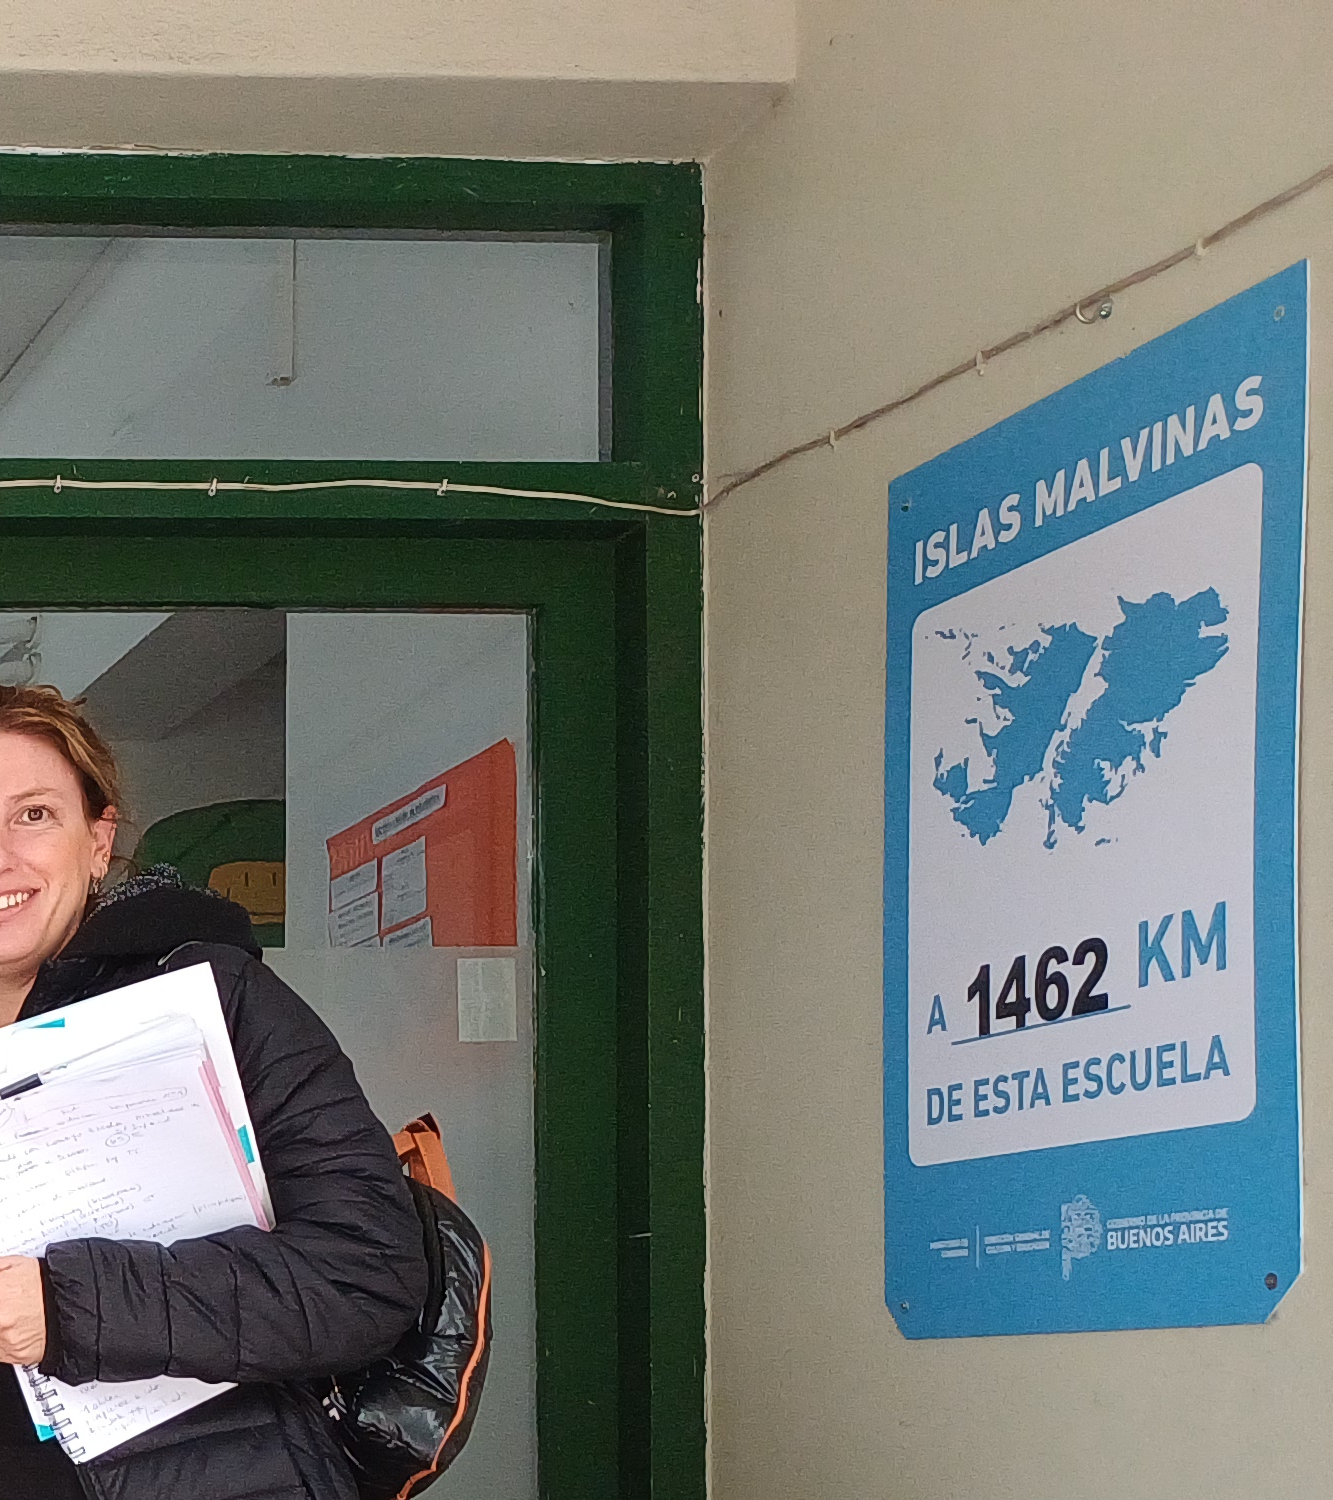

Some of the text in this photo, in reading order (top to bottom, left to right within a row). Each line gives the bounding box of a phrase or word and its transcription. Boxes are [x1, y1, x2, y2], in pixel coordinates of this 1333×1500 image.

[913, 375, 1264, 586] ISLAS MALVINAS
[926, 901, 1227, 1038] A 1462 KM
[926, 1034, 1231, 1126] DE ESTA ESCUELA
[1107, 1220, 1229, 1250] BUENOS AIRES
